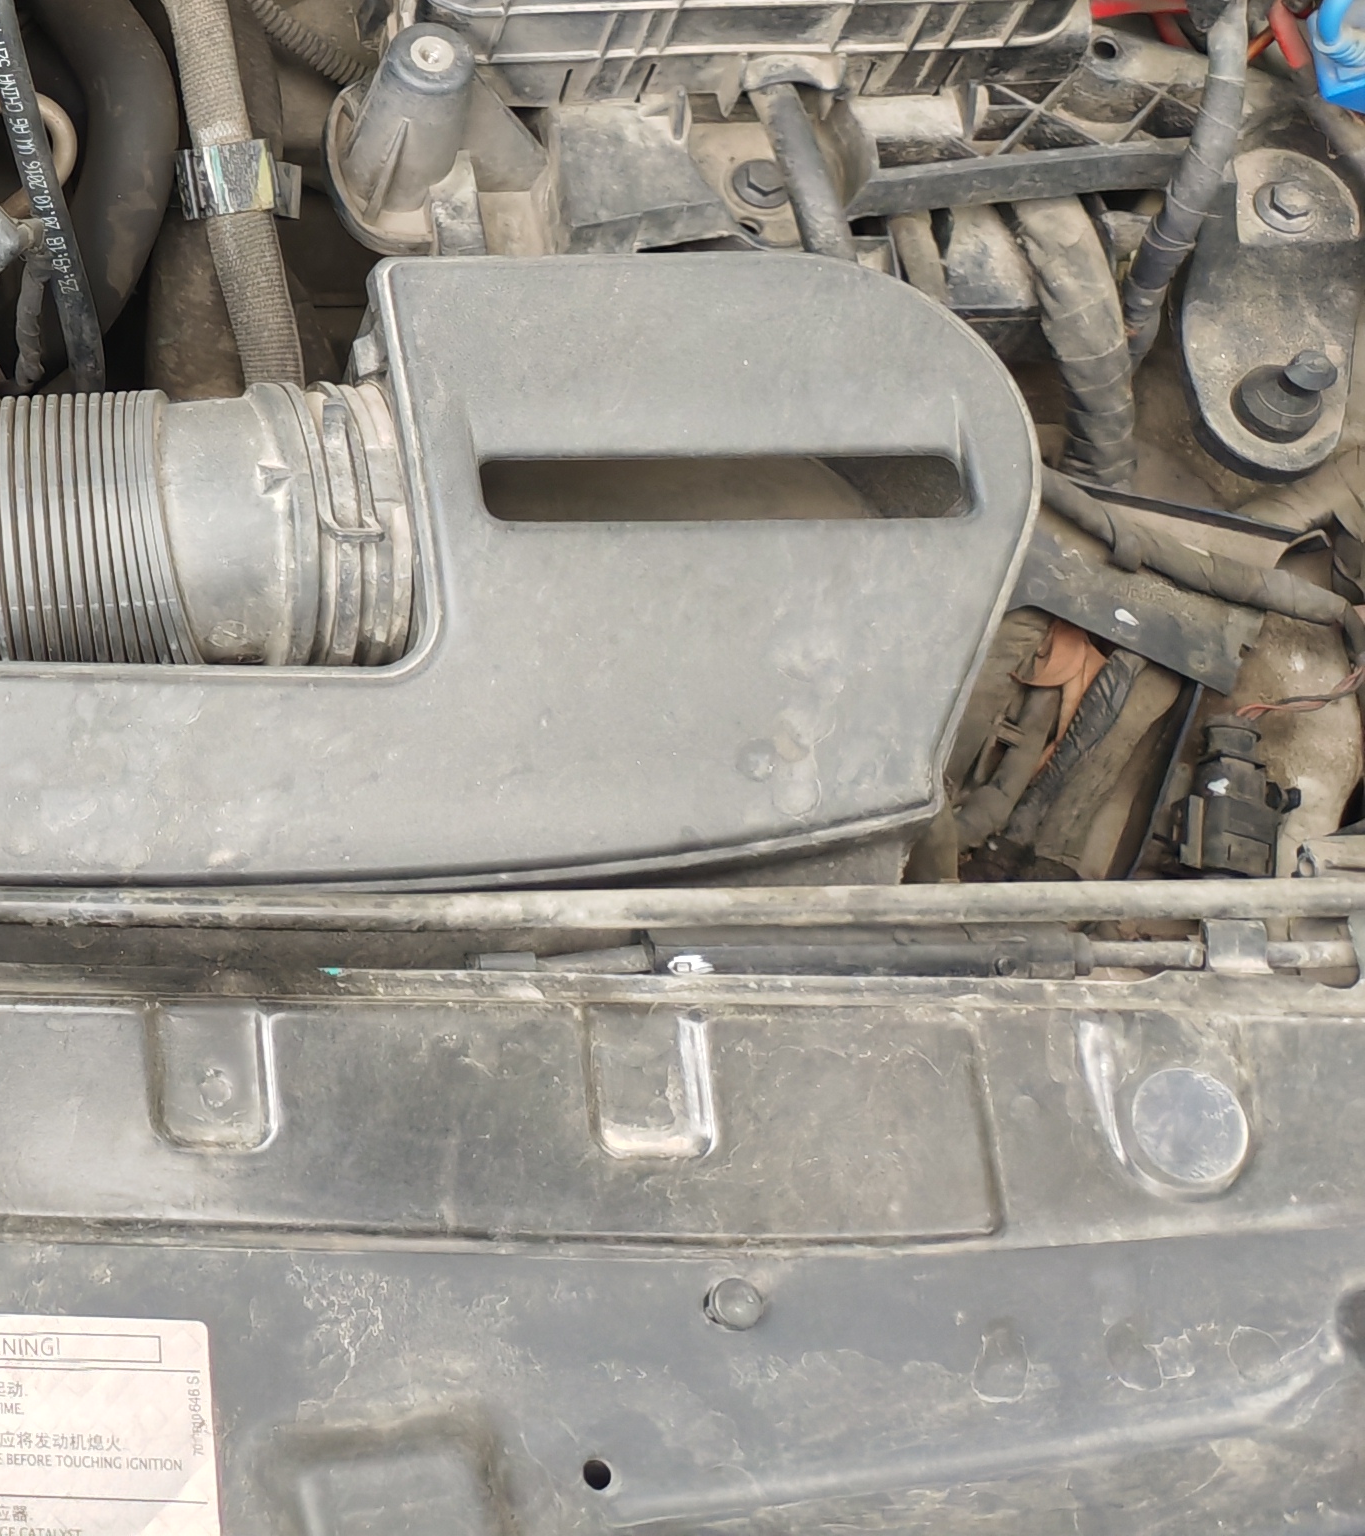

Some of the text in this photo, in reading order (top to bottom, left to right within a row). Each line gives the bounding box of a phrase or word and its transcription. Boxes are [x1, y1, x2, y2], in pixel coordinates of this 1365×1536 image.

[6, 1453, 53, 1467] BEFORE
[57, 1454, 123, 1470] TOUCHING
[126, 1457, 183, 1471] IGNITION
